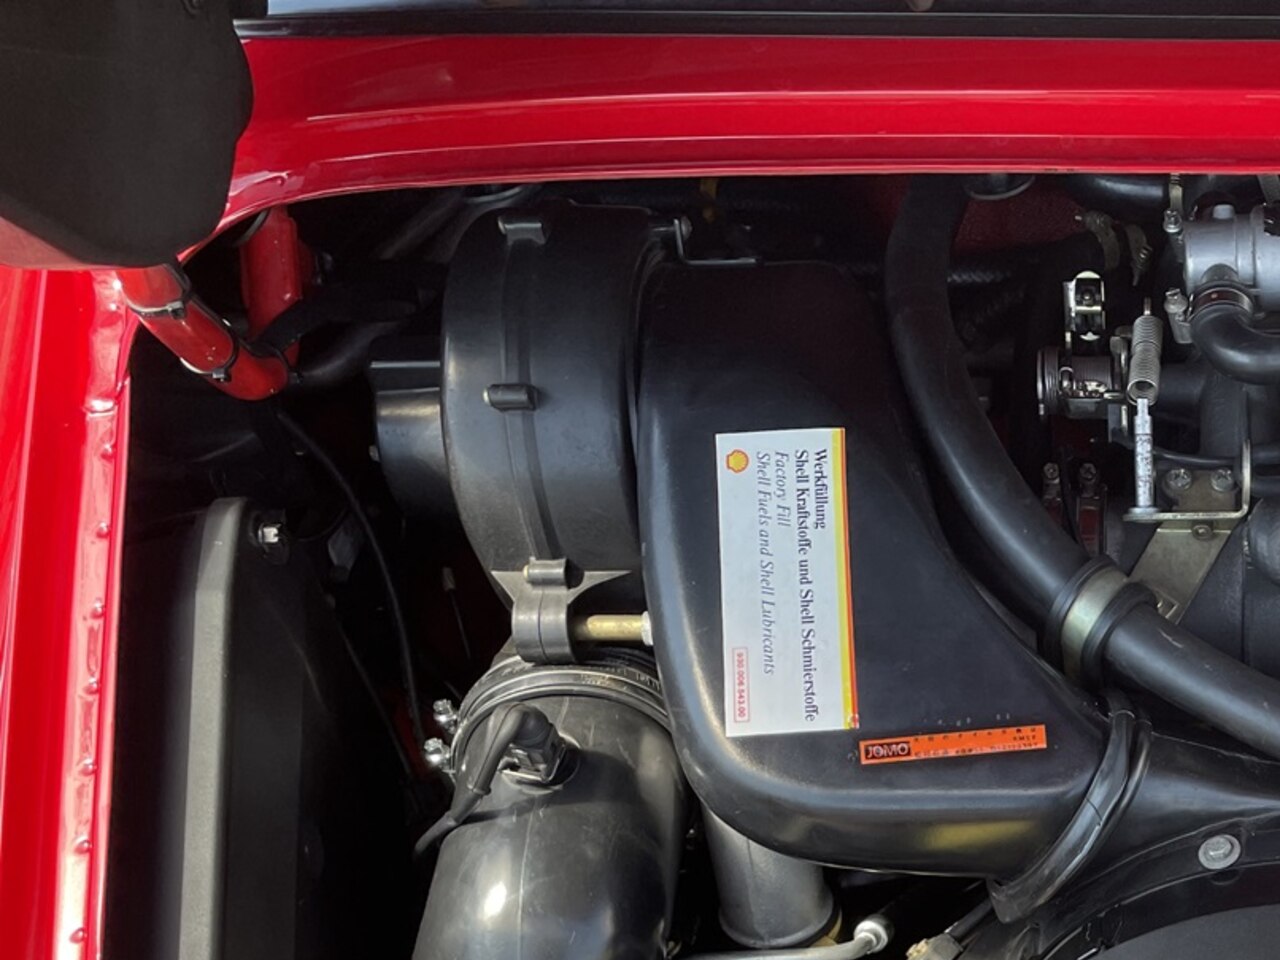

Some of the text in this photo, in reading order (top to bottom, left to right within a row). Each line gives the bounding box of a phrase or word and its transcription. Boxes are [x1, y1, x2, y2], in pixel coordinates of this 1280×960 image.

[773, 451, 791, 526] Factory Fill
[814, 449, 828, 529] Werkfüllung
[757, 451, 776, 675] Shell Fuels and Shell Lubricants
[794, 449, 819, 722] Shell Kraftstoffe und Shell Schmierstoffe
[867, 743, 909, 759] JOMO
